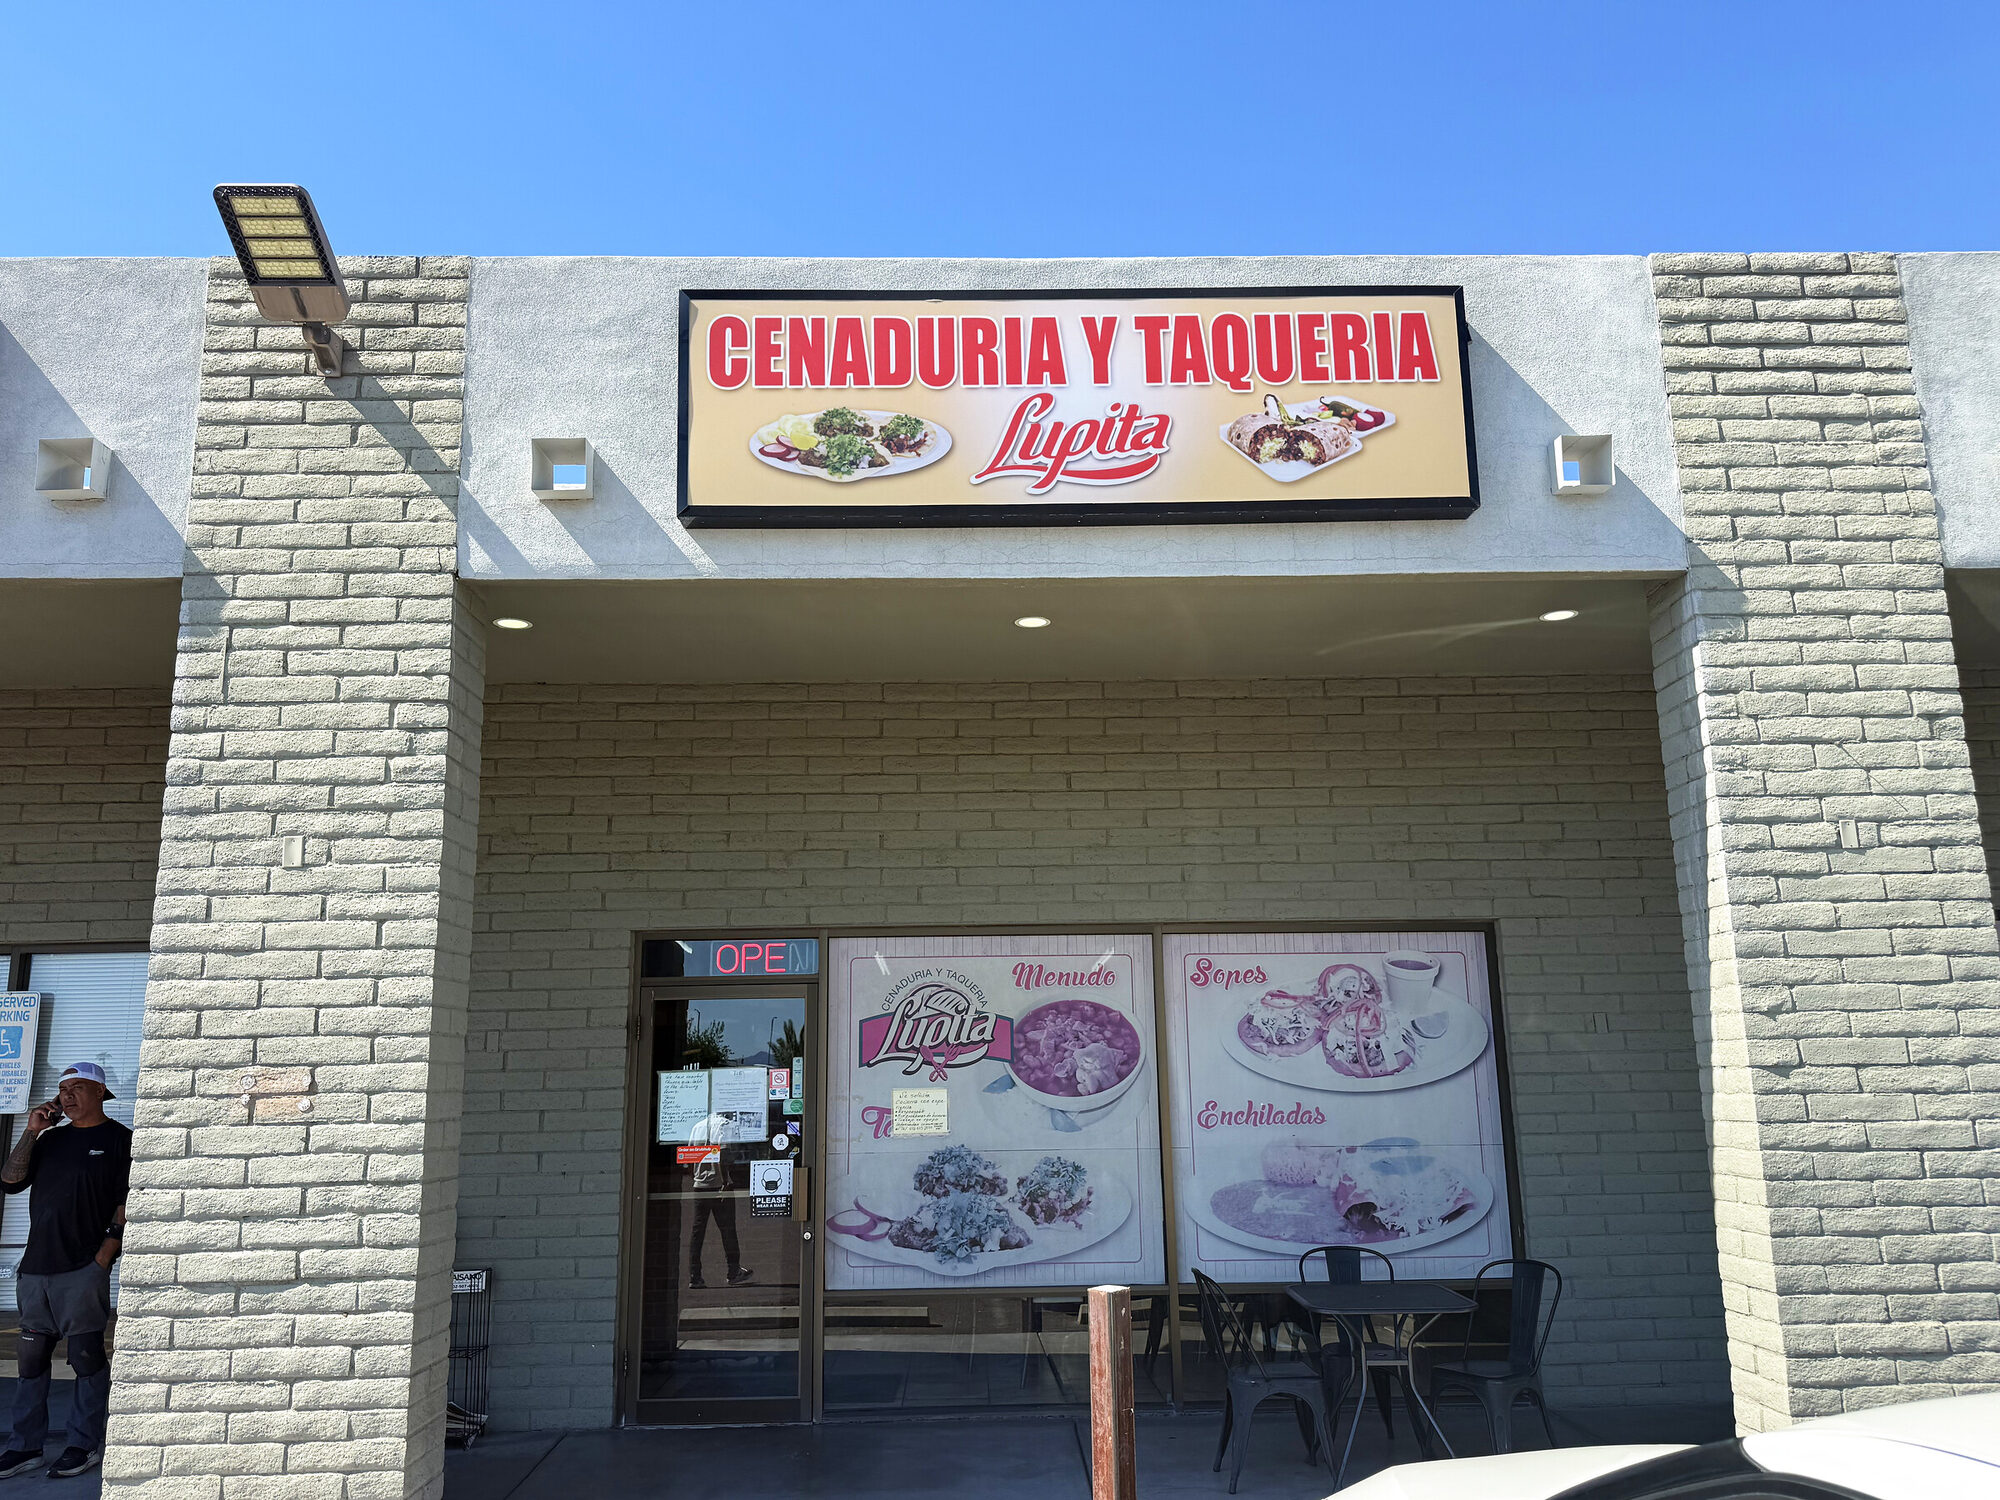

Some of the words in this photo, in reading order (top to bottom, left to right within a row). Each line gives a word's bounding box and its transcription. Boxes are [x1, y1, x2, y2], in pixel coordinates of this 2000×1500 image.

[707, 315, 1068, 389] CENADURIA
[1081, 316, 1119, 385] Y
[1134, 312, 1440, 392] TAQUERIA
[970, 393, 1172, 494] Lupita
[717, 943, 808, 974] OPEN
[1190, 958, 1268, 990] Sopes
[881, 968, 932, 1011] CENADURIA
[936, 968, 943, 977] Y
[947, 969, 988, 1008] TAQUERIA
[1012, 962, 1116, 991] Menudo
[866, 996, 997, 1076] Lupita
[1197, 1100, 1327, 1129] Enchiladas
[756, 1196, 787, 1204] PLEASE
